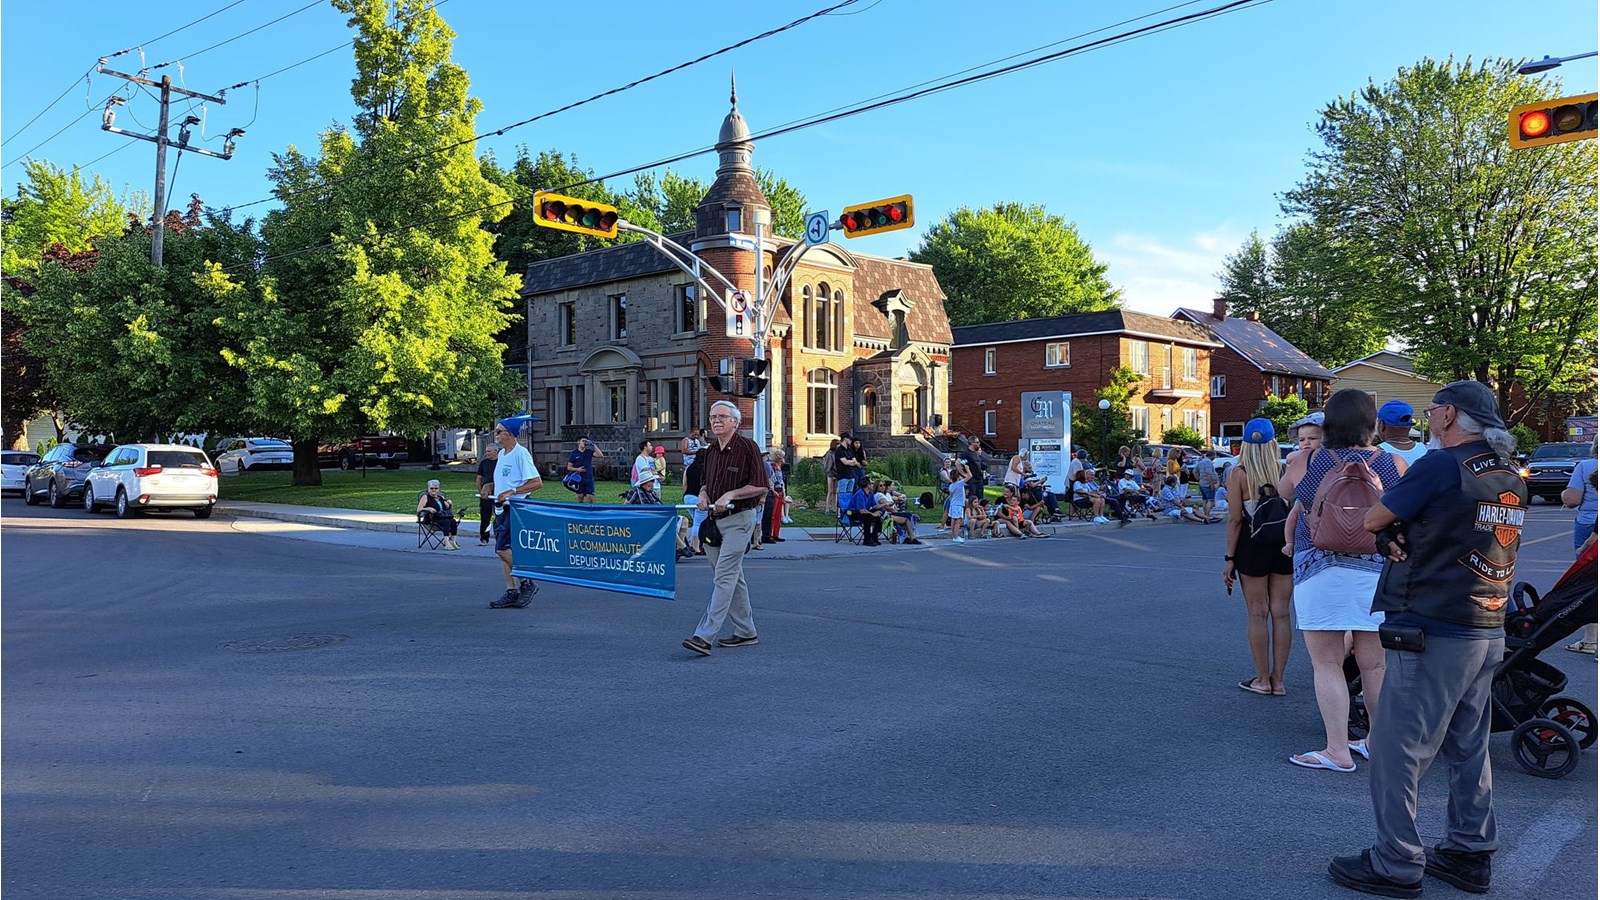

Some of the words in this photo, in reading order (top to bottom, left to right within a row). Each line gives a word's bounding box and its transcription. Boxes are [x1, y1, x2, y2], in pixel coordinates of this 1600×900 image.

[1473, 459, 1495, 471] LIVE
[567, 522, 605, 537] ENGAGÉE
[607, 527, 631, 538] DANS
[1474, 523, 1493, 531] TRADE
[518, 529, 560, 553] CEZinc
[568, 540, 579, 550] LA
[580, 540, 642, 555] COMMUNAUTÉ
[569, 554, 598, 568] DEPUIS
[600, 557, 621, 570] PLUS
[623, 560, 634, 572] DE
[636, 561, 646, 573] 55
[647, 563, 665, 576] ANS
[1470, 554, 1493, 575] RIDE
[1496, 570, 1504, 578] TO
